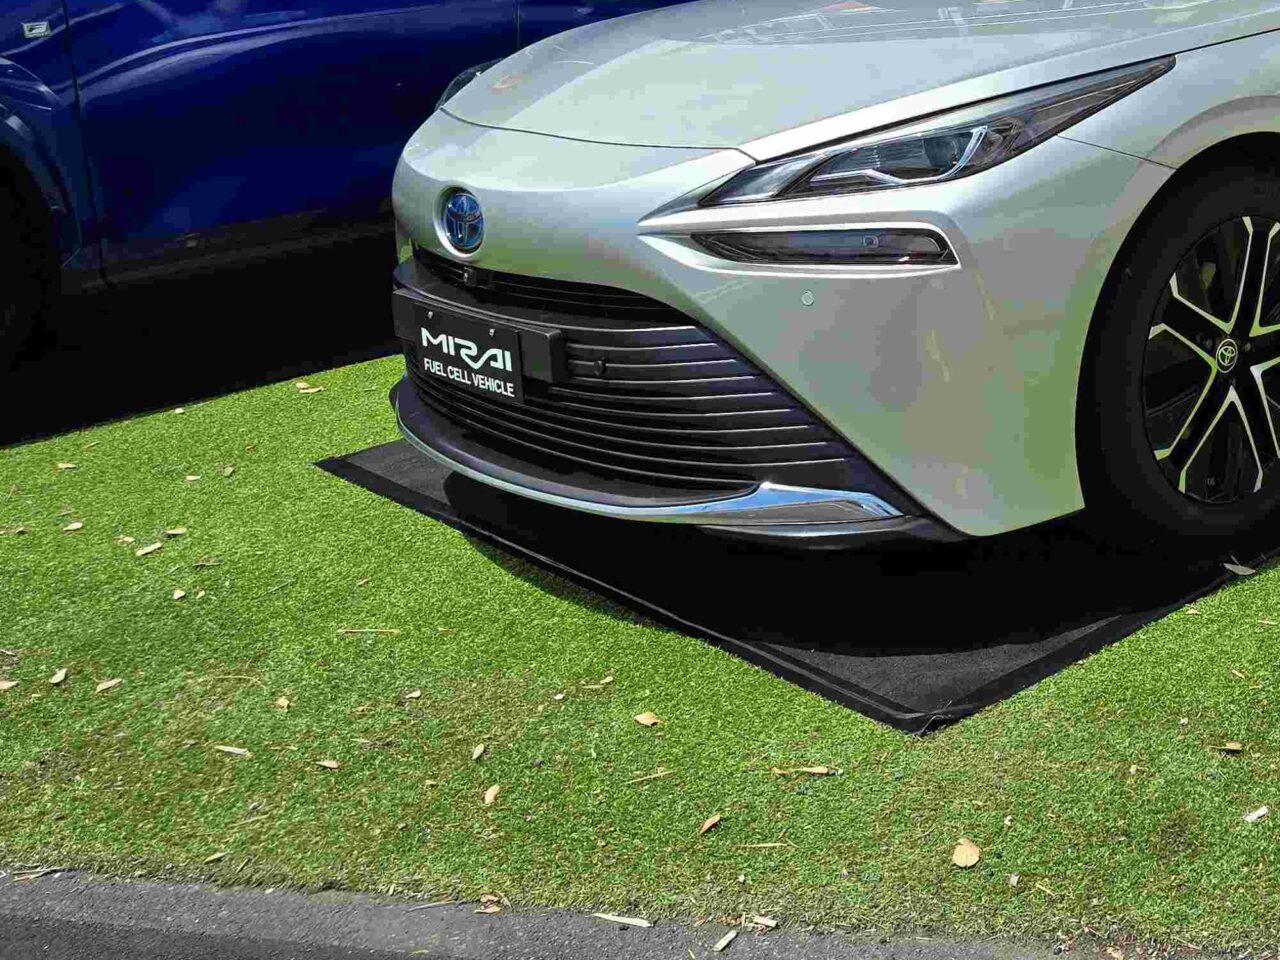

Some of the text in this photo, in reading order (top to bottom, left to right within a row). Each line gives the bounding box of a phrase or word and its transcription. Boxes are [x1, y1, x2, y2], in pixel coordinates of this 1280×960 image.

[421, 327, 513, 372] MIRAI
[424, 358, 515, 397] FUEL CELL VEHICLE
